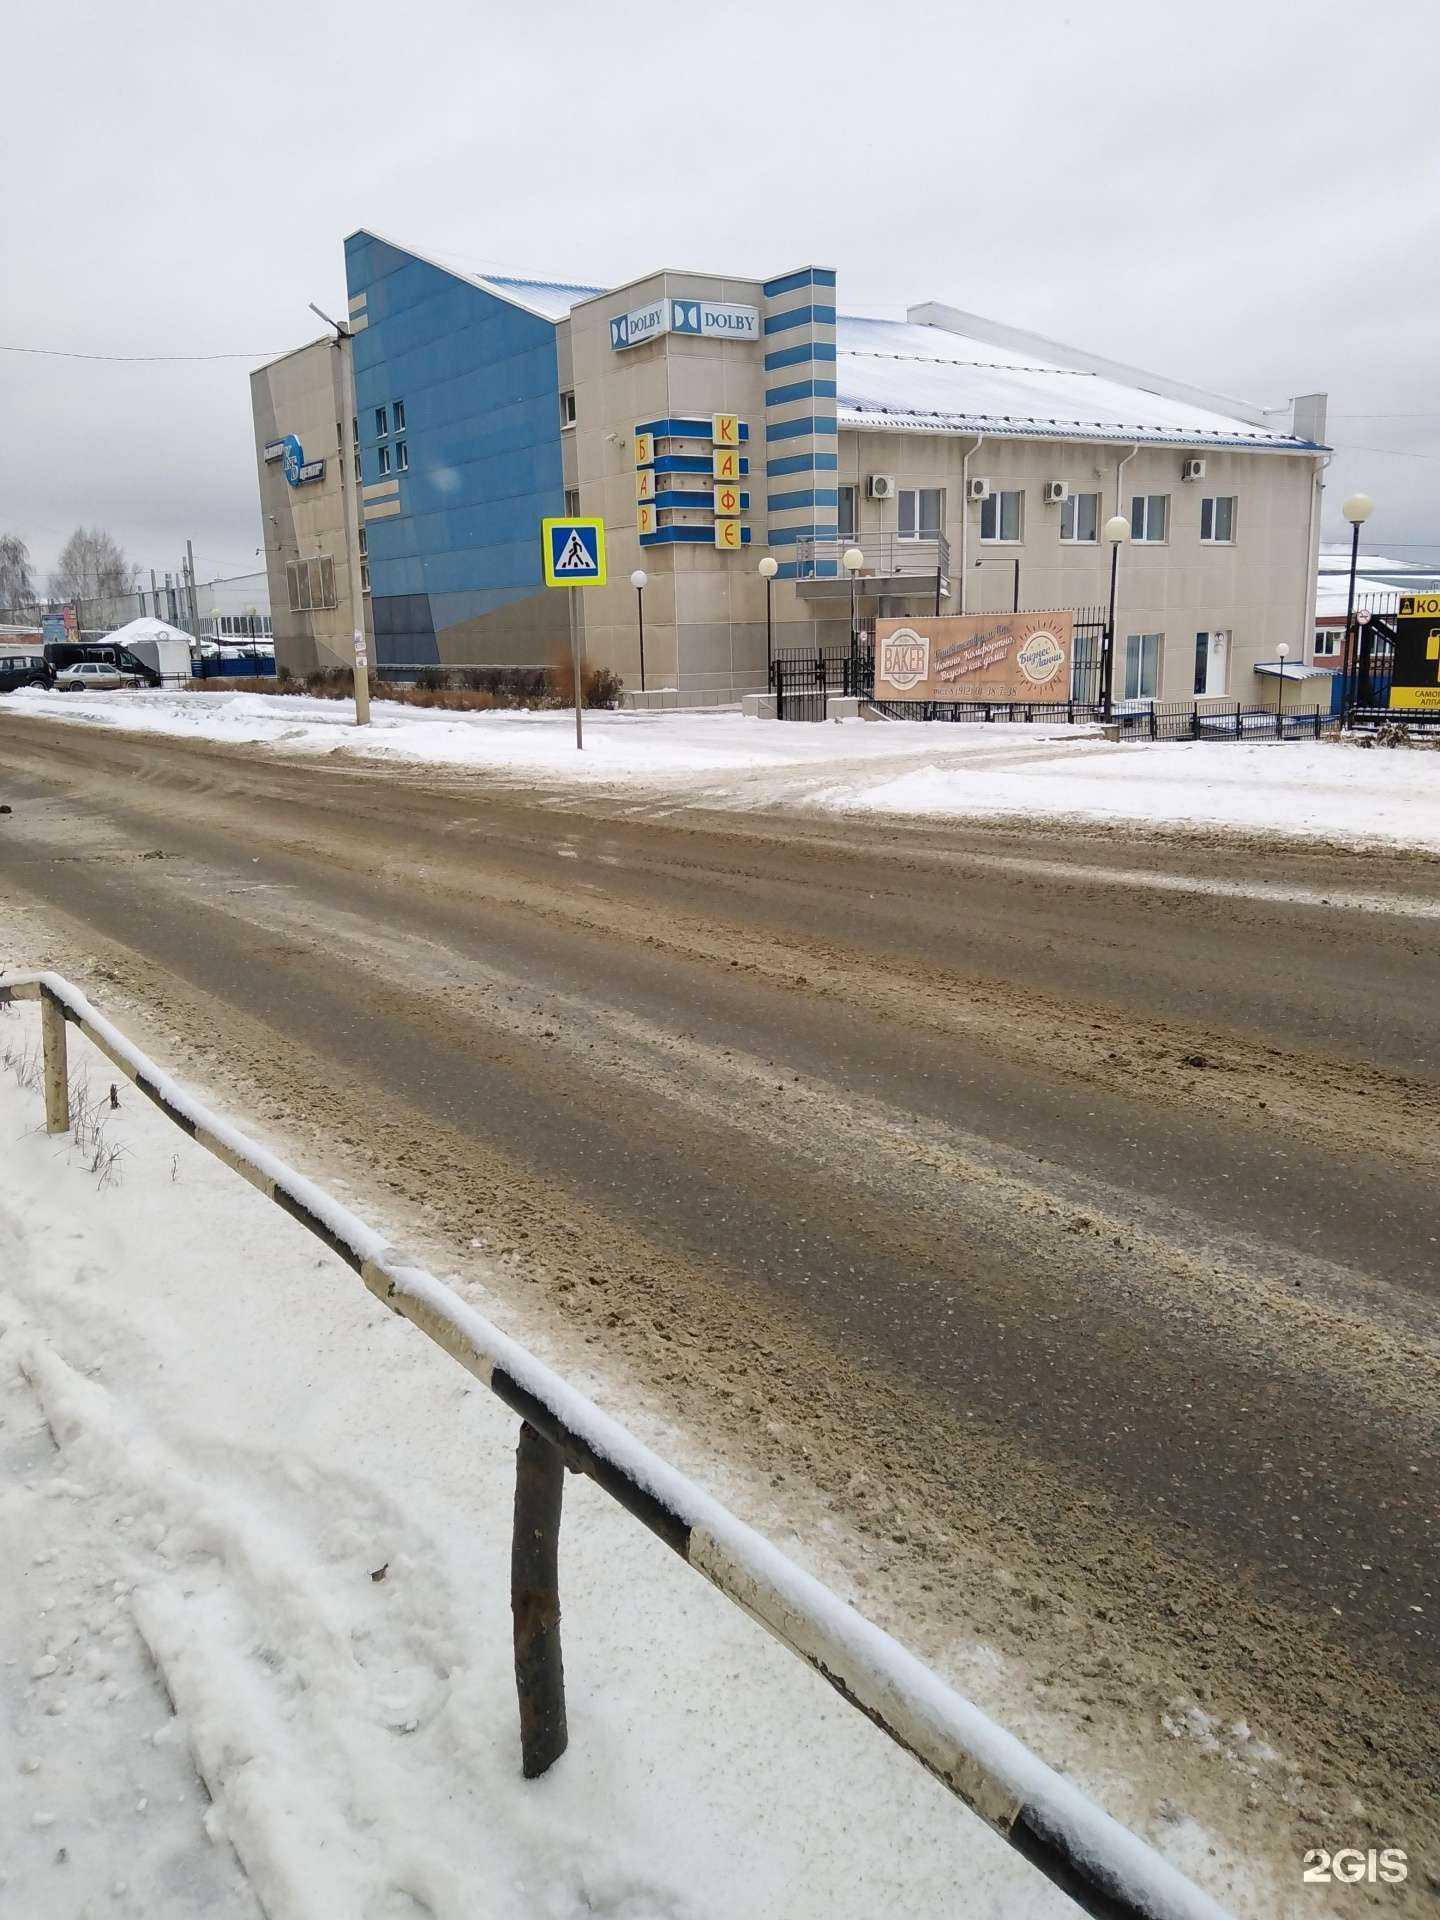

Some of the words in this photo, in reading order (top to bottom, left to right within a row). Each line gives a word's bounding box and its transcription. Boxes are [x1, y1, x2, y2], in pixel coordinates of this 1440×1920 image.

[630, 309, 663, 334] DOLBY
[705, 312, 755, 331] DOLBY
[1416, 599, 1440, 613] КО
[884, 647, 925, 671] BAKER
